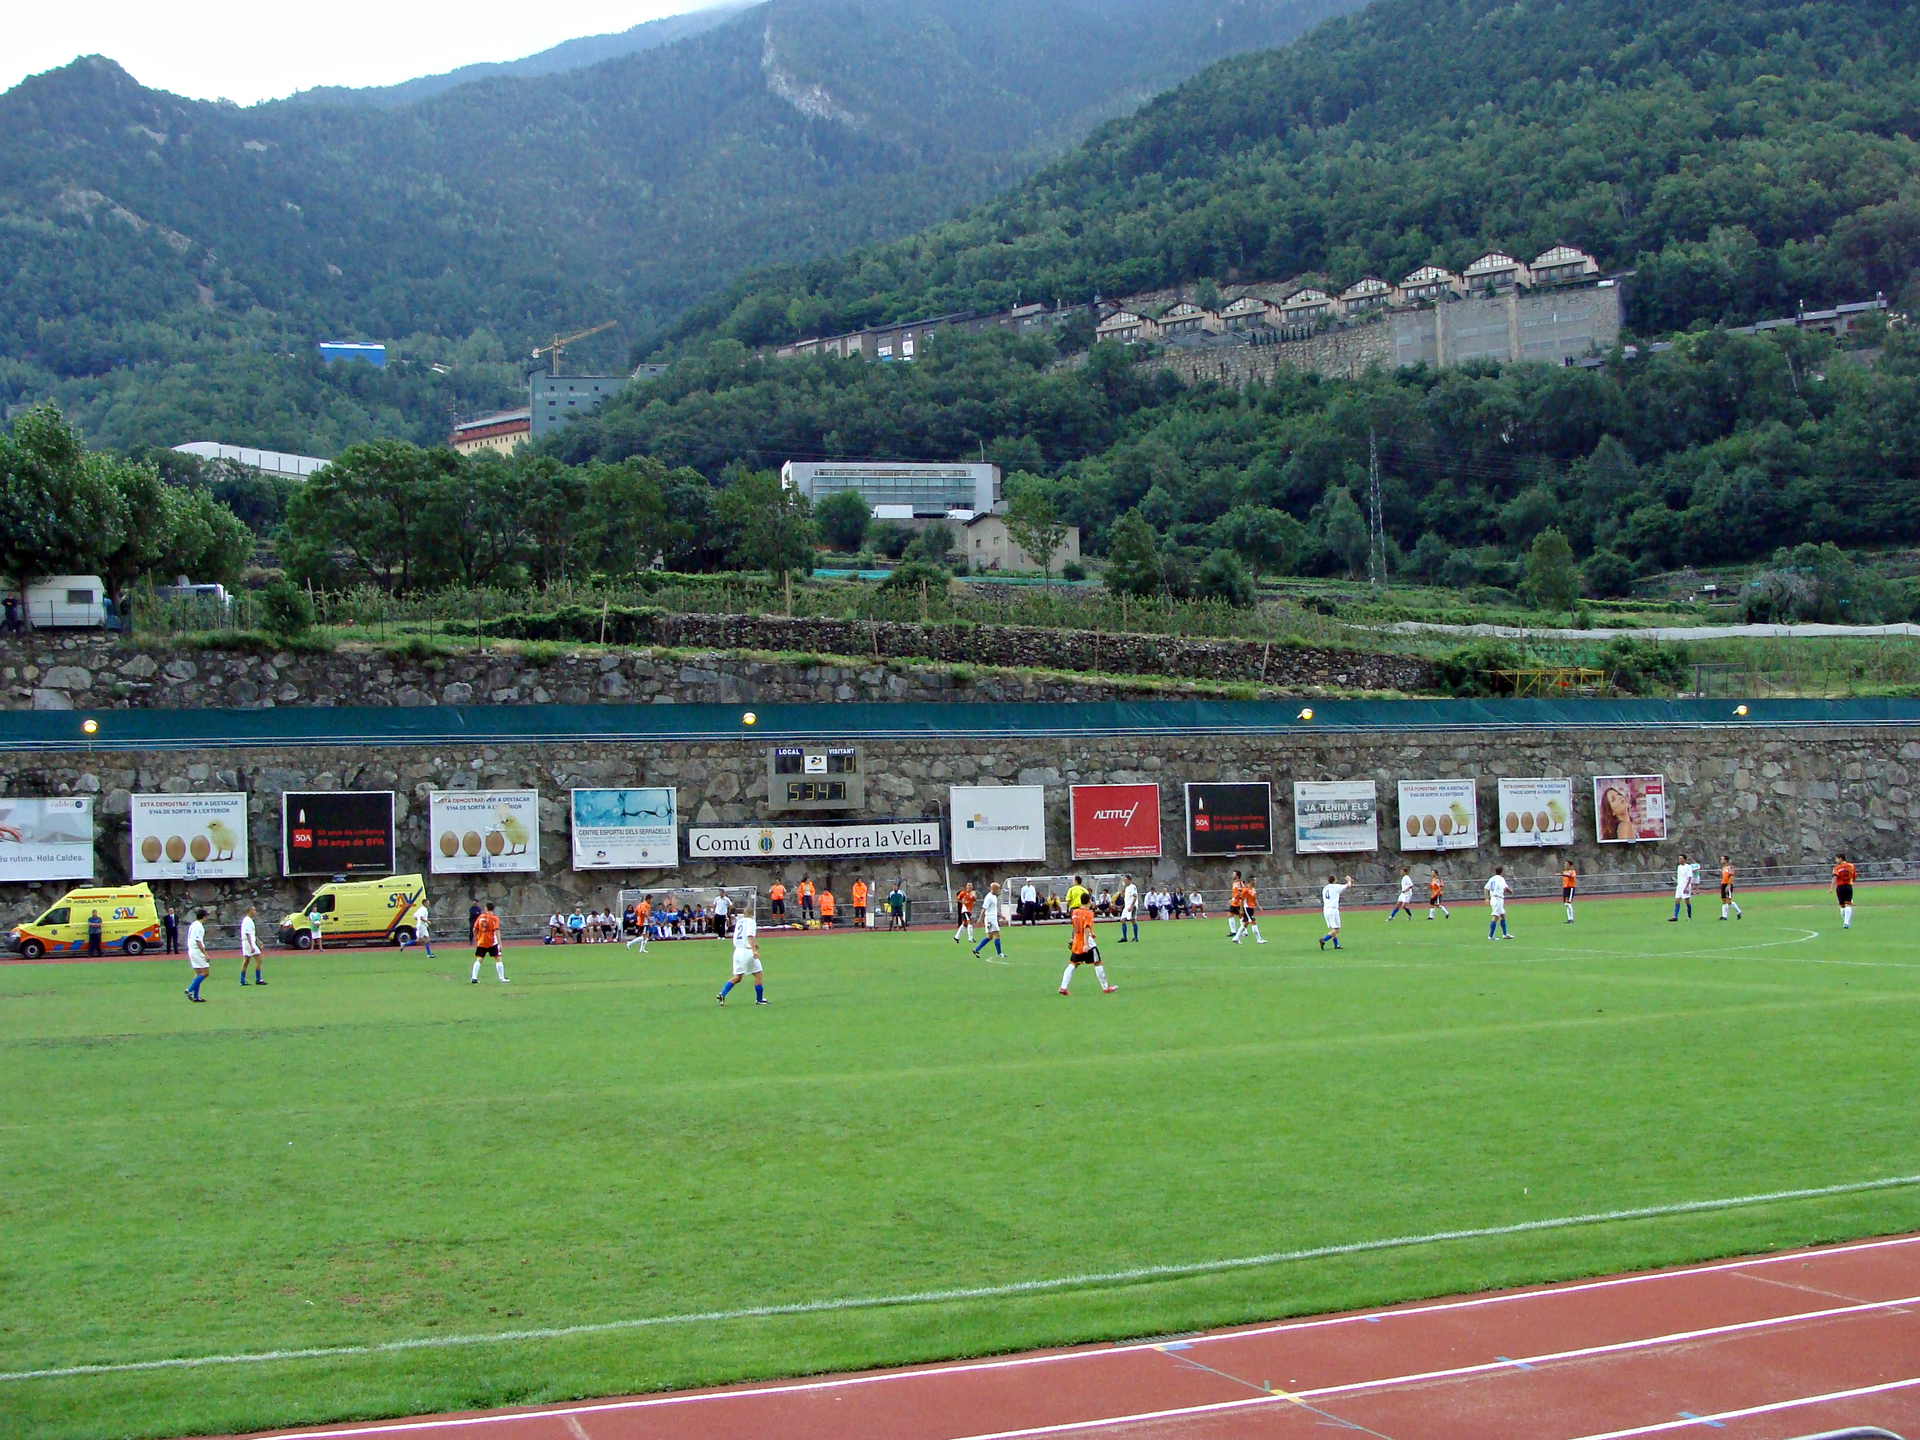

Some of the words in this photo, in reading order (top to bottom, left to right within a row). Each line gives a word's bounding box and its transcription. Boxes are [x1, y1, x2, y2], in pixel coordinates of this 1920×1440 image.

[844, 756, 855, 772] 0
[1319, 803, 1348, 811] TENIM
[1351, 802, 1369, 810] ELS
[366, 838, 385, 846] BPA
[696, 834, 750, 851] Comú
[782, 832, 870, 849] d'Andorra
[875, 830, 888, 846] la
[891, 829, 931, 845] Vella
[1325, 890, 1330, 900] 4
[737, 924, 743, 939] 2
